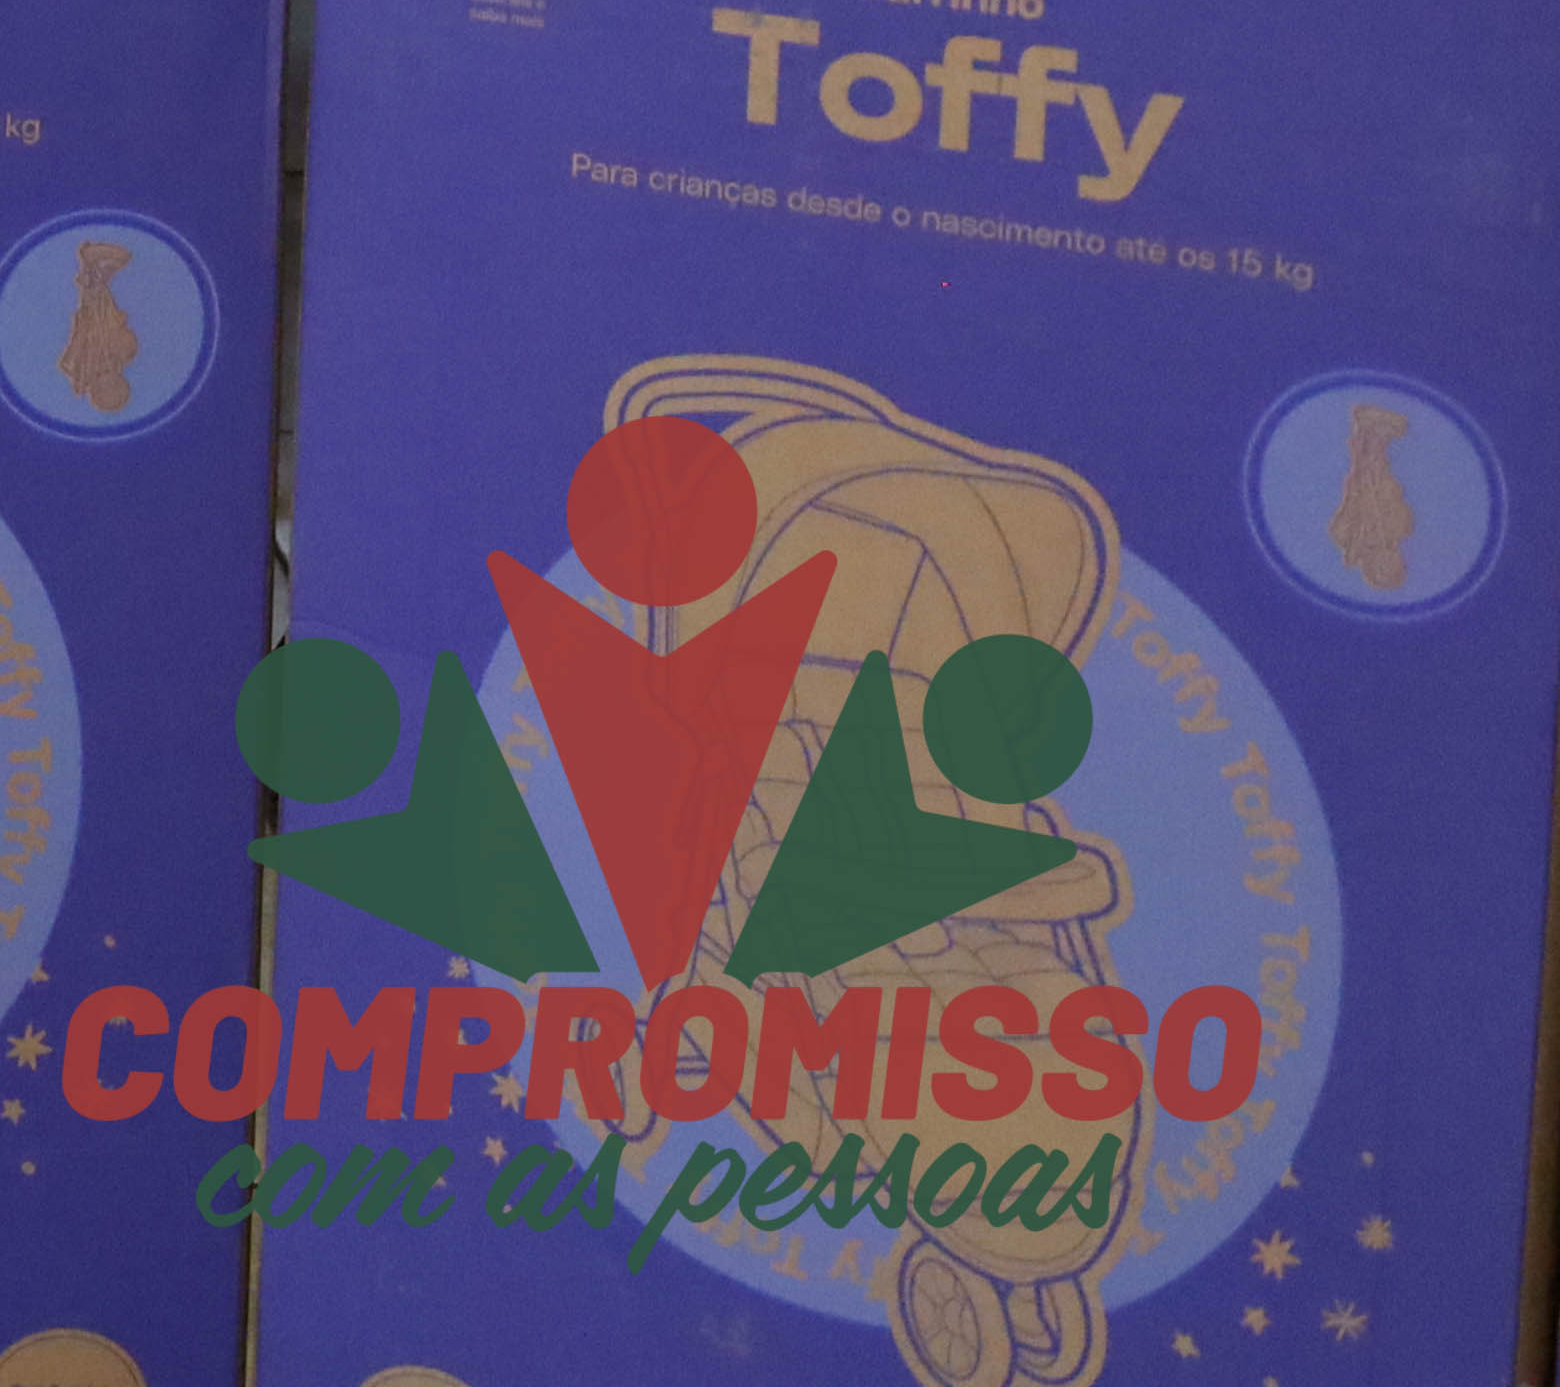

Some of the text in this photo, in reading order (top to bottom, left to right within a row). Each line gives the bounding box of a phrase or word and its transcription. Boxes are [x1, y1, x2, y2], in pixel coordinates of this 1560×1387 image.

[3, 111, 42, 147] kg
[710, 5, 1186, 204] Toffy
[570, 151, 1316, 292] Para crianças desde o nascimento até os 15 kg
[1111, 589, 1232, 739] Toffy
[1220, 740, 1306, 904] Toffy
